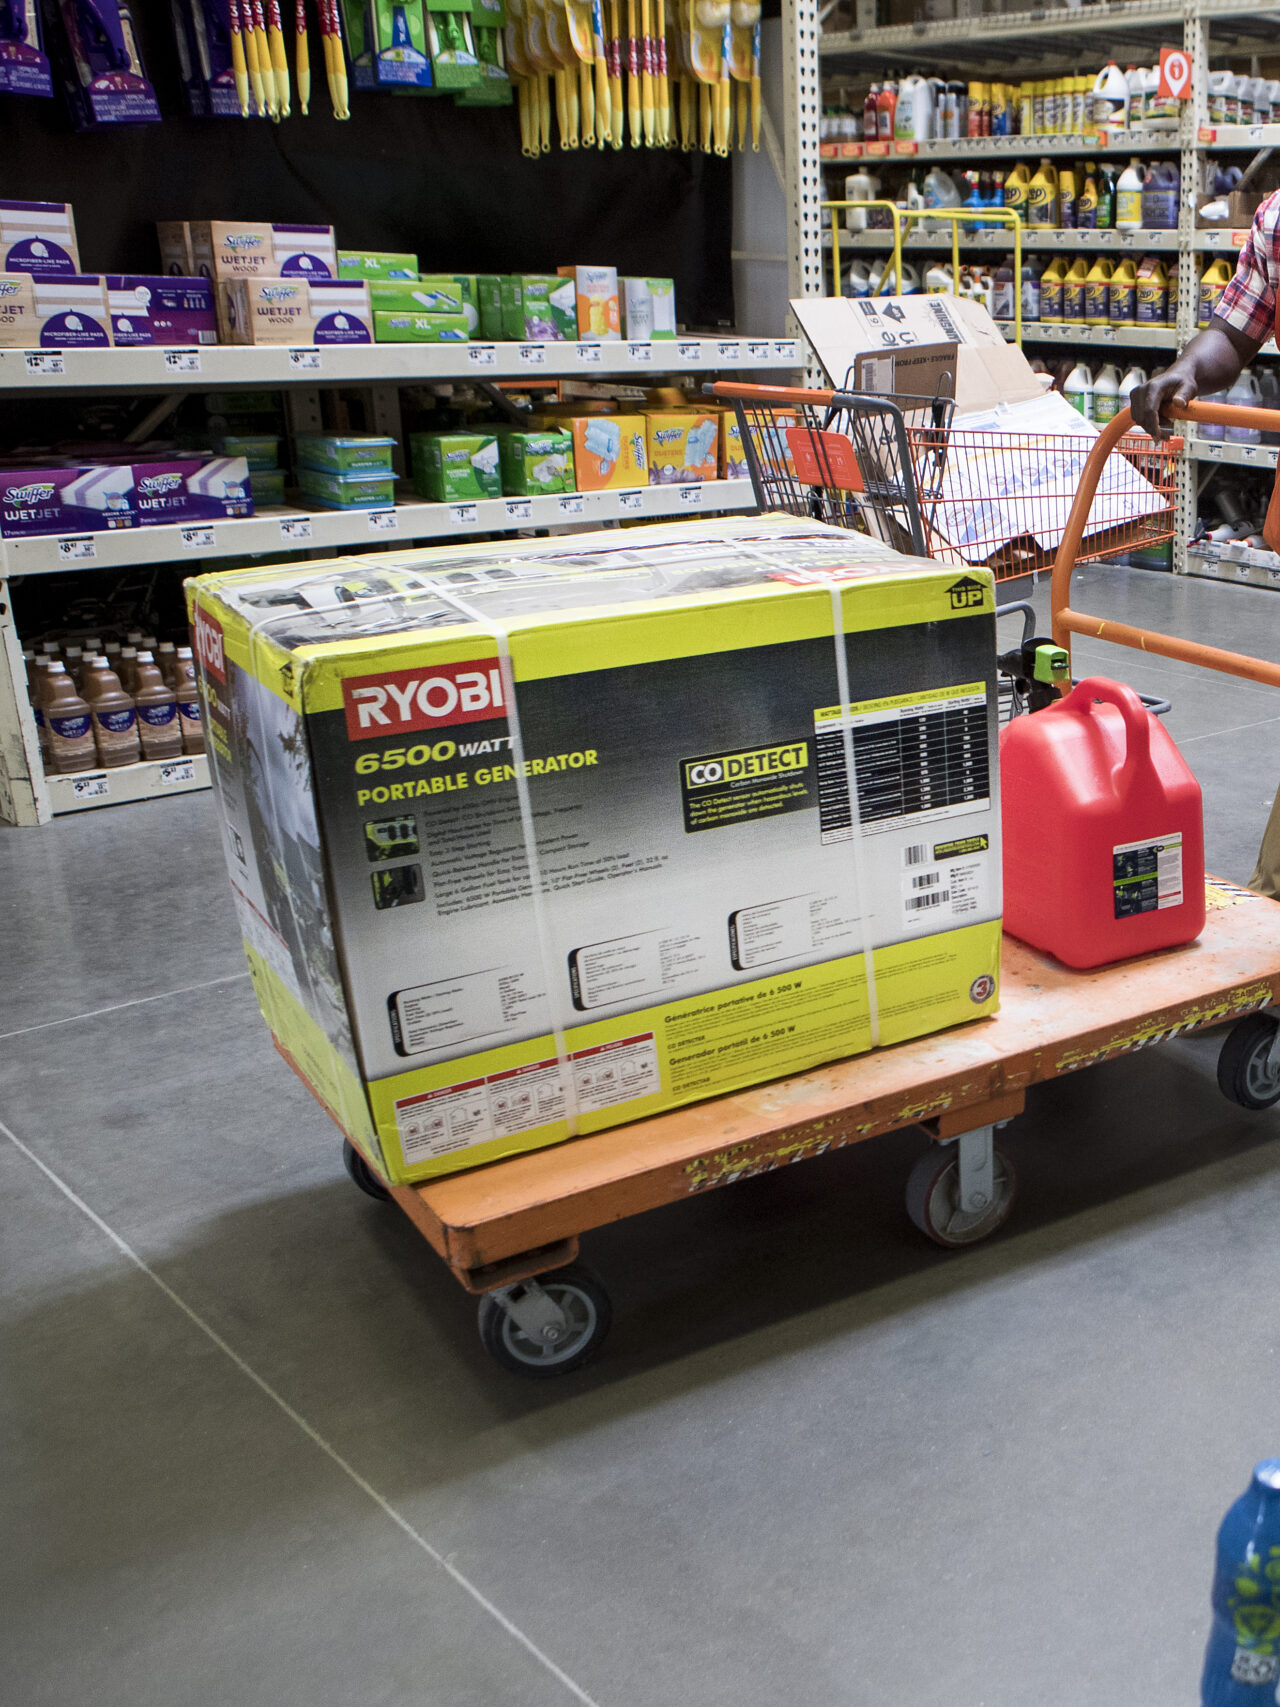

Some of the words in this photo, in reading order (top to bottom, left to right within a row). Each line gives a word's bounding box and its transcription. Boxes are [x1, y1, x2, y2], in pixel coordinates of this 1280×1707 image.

[224, 234, 262, 249] Swiffer
[221, 255, 267, 265] WETJET
[364, 257, 381, 268] XL
[0, 284, 19, 296] ffer
[259, 286, 297, 301] Swiffer
[257, 307, 302, 316] WETJET
[267, 316, 294, 324] WOOD
[415, 318, 431, 329] XL
[138, 475, 182, 494] Swiffer
[3, 485, 54, 504] Swiffer
[138, 496, 187, 510] WETJET
[4, 508, 61, 521] WETJET
[952, 590, 983, 608] UP
[352, 668, 504, 728] RYOBI
[355, 740, 457, 775] 6500
[458, 735, 519, 758] WATT
[690, 762, 723, 785] CO
[727, 747, 803, 778] DETECT
[357, 772, 470, 807] PORTABLE
[474, 749, 600, 786] GENERATOR
[717, 992, 755, 1011] portative
[757, 989, 768, 1000] de
[777, 983, 793, 995] 500
[793, 981, 803, 990] W
[976, 980, 988, 997] 3
[669, 1046, 716, 1066] Generador
[770, 1027, 786, 1039] 500
